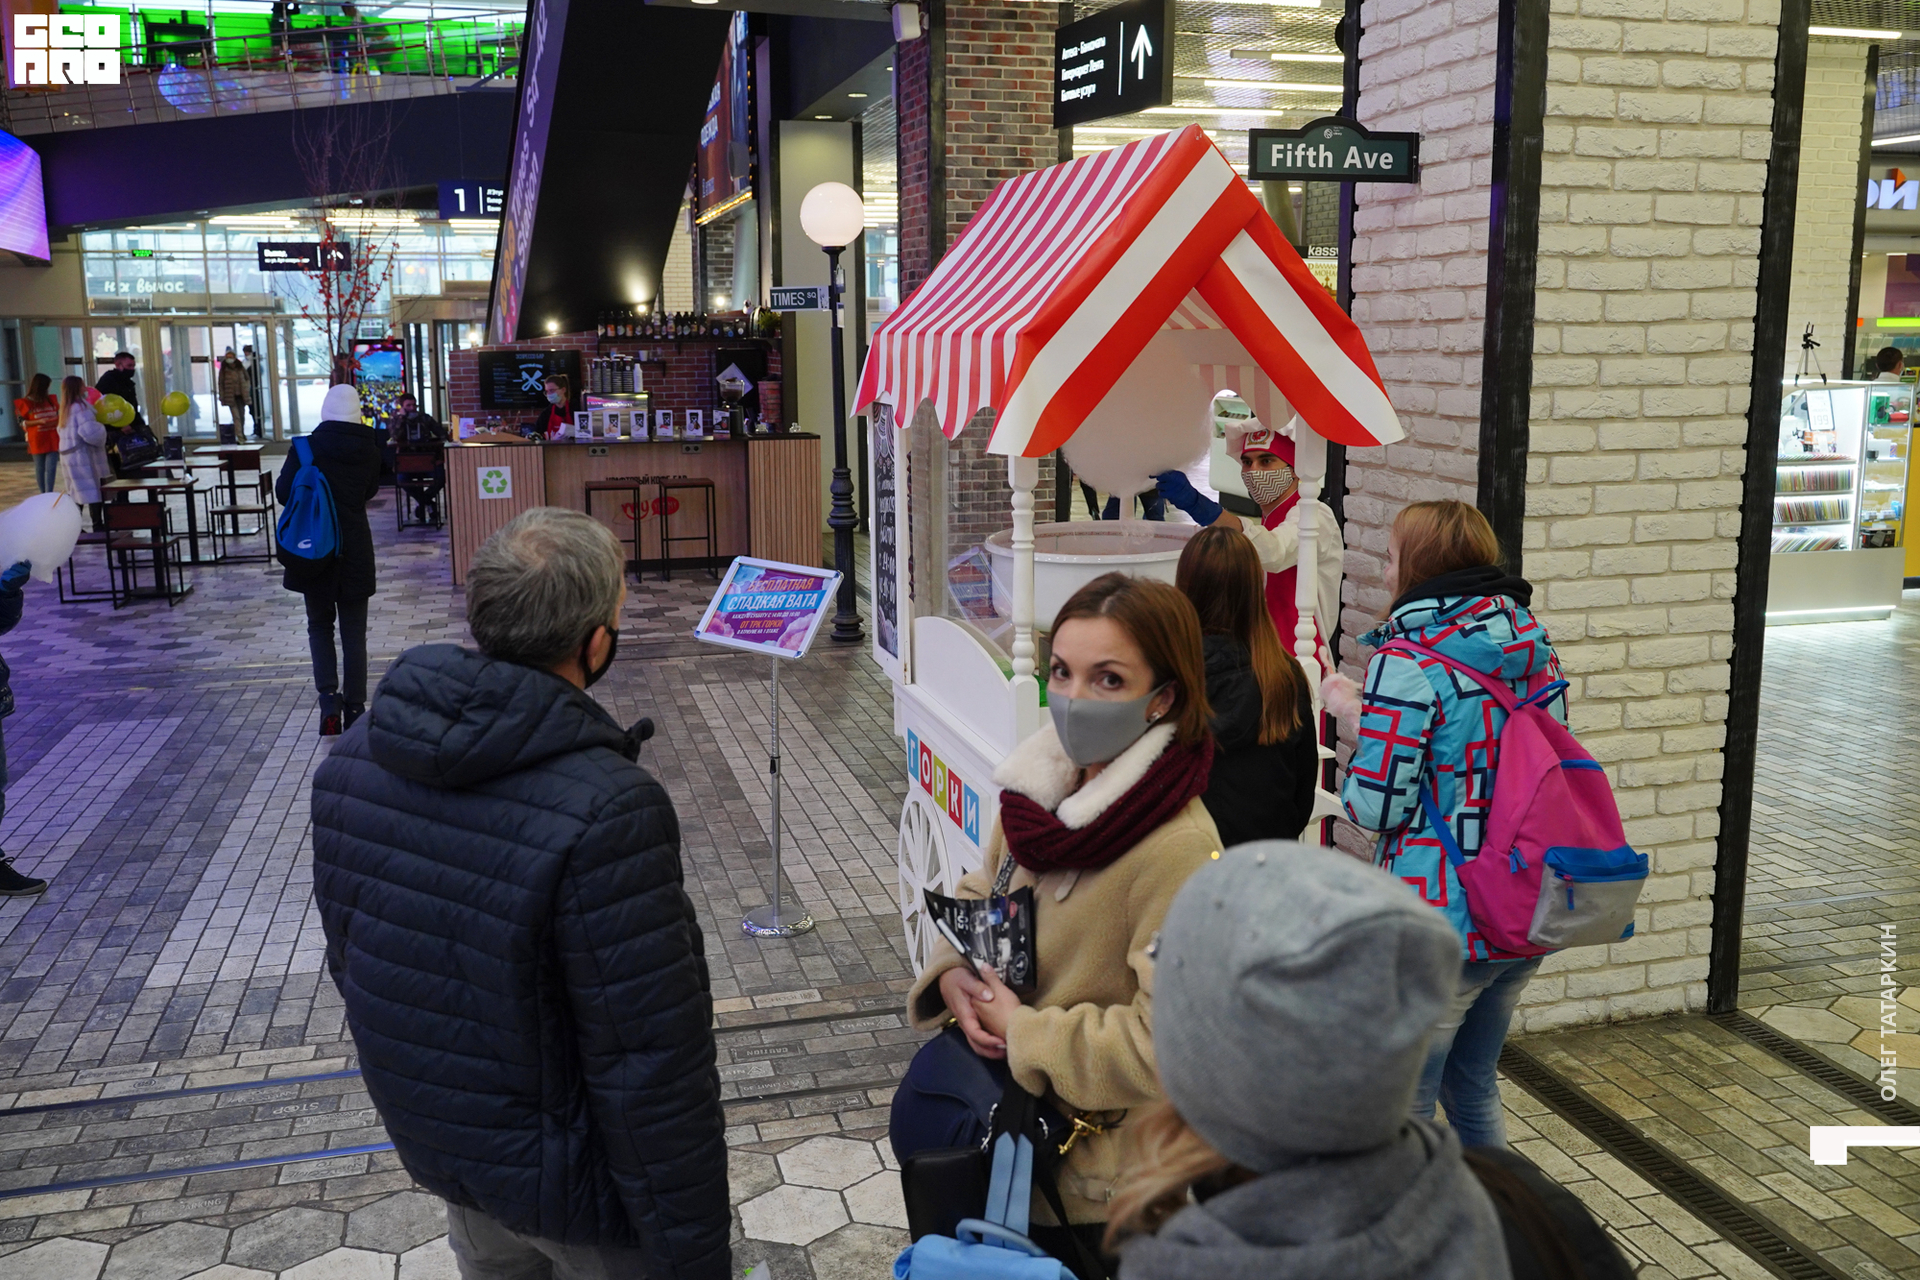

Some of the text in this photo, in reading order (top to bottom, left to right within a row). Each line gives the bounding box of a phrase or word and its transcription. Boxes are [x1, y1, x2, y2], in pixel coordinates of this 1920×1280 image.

[1271, 143, 1394, 170] Fifth Ave
[454, 188, 466, 212] 1
[771, 291, 817, 306] TIMES SQ
[747, 577, 815, 592] БЕСПЛАТНАЯ
[727, 593, 819, 610] СЛАДКАЯ ВАТА
[740, 619, 784, 629] ОТ ТРК ГОРКИ
[909, 740, 978, 837] ГОРКИ
[746, 1047, 789, 1056] CAUTION
[273, 1102, 320, 1115] STOP
[180, 1198, 222, 1210] PARKING
